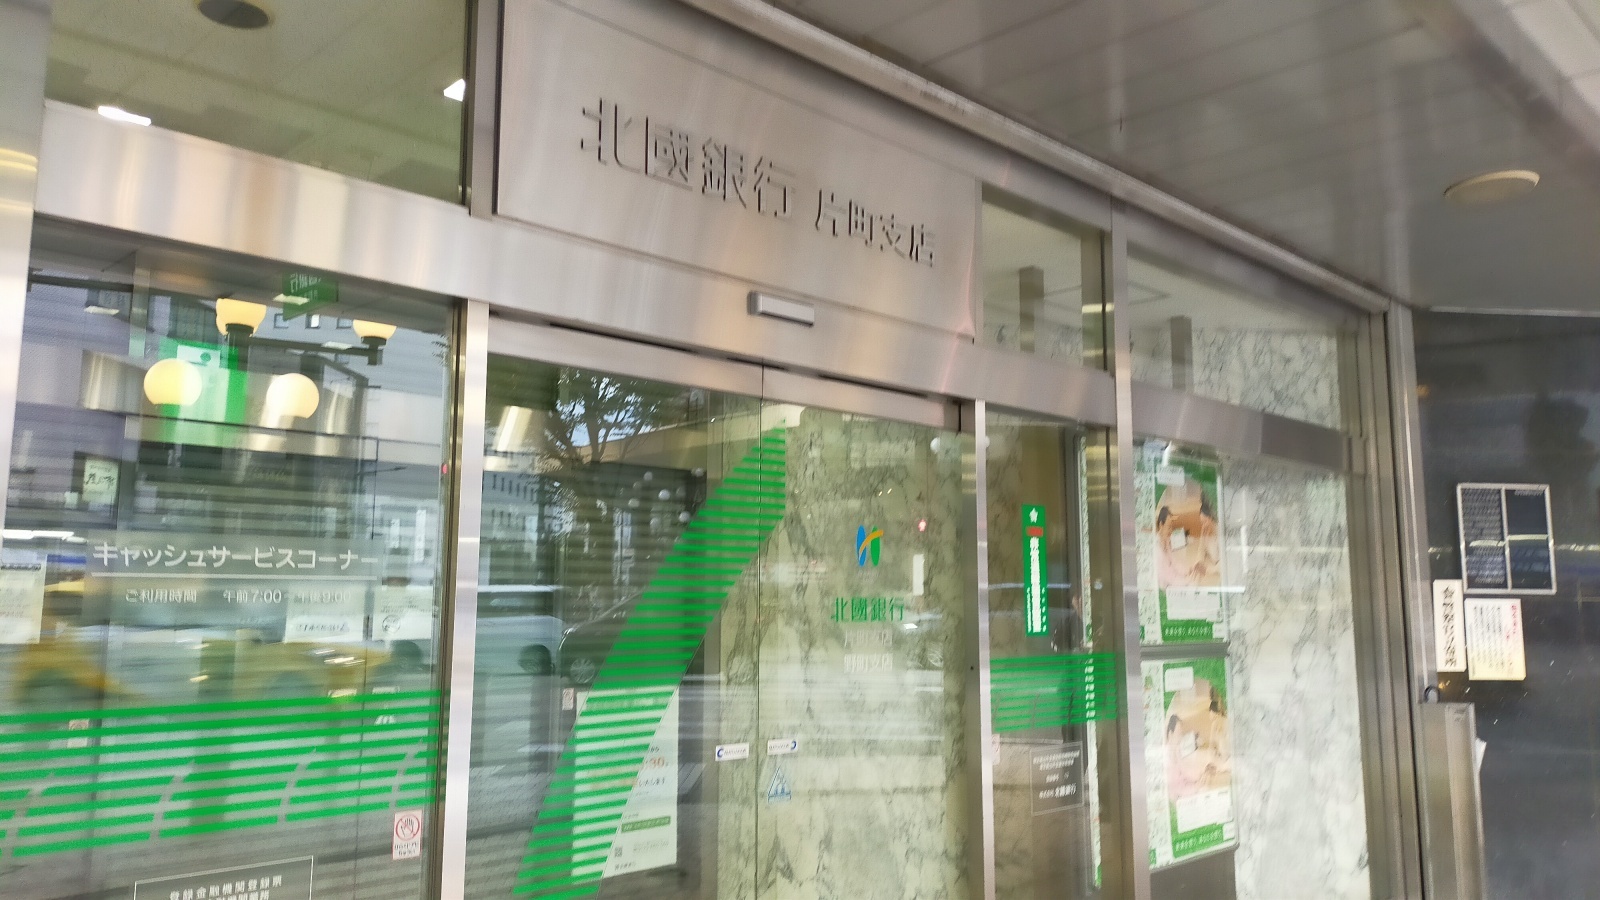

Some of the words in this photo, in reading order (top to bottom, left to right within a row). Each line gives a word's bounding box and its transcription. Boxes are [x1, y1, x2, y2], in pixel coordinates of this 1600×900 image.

[581, 98, 797, 219] 北國銀行
[815, 188, 936, 268] 片町支店
[93, 541, 379, 569] キャッシュサービスコーナー
[125, 588, 197, 604] ご利用時間
[222, 588, 282, 604] 午前7:00
[831, 597, 905, 622] 北國銀行
